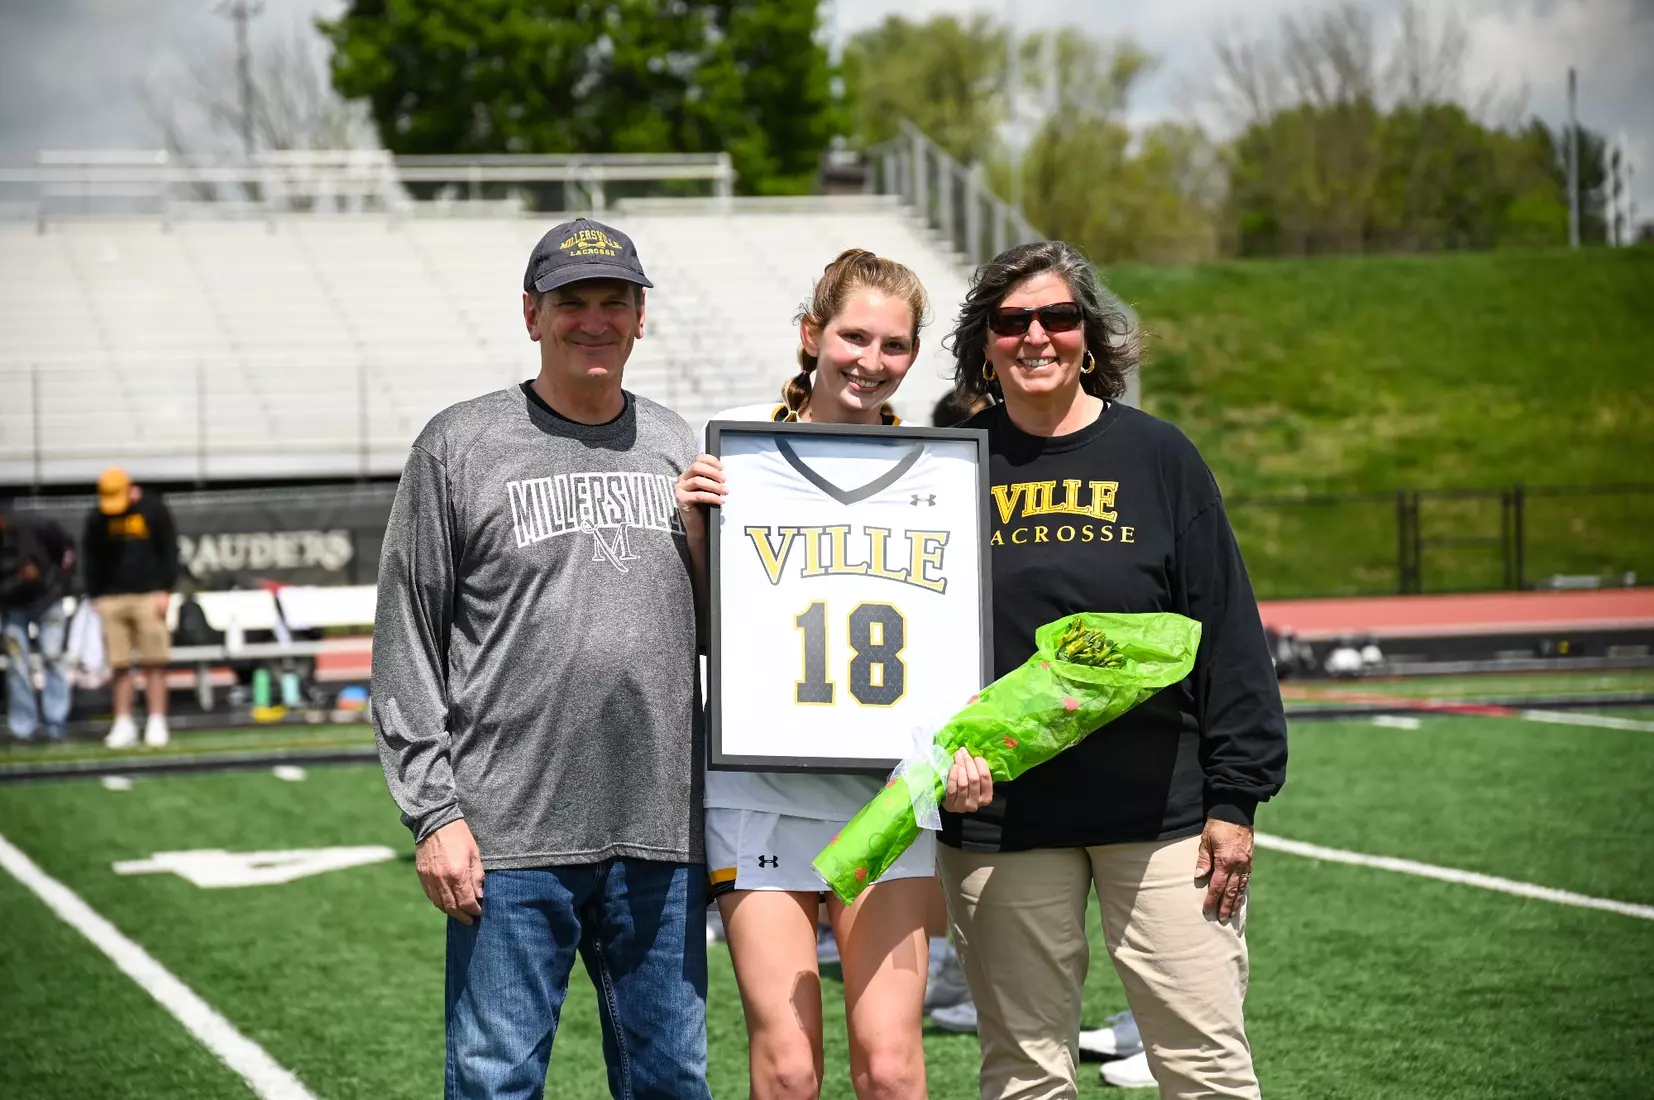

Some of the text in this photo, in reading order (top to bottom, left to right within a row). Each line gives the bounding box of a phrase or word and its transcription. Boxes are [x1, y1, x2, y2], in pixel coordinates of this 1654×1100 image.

[570, 248, 615, 256] LACROSSE
[506, 472, 686, 548] MILLERSVILL
[991, 479, 1119, 524] VILLE
[744, 524, 950, 595] VILLE
[990, 525, 1135, 545] ACROSSE
[794, 599, 907, 708] 18
